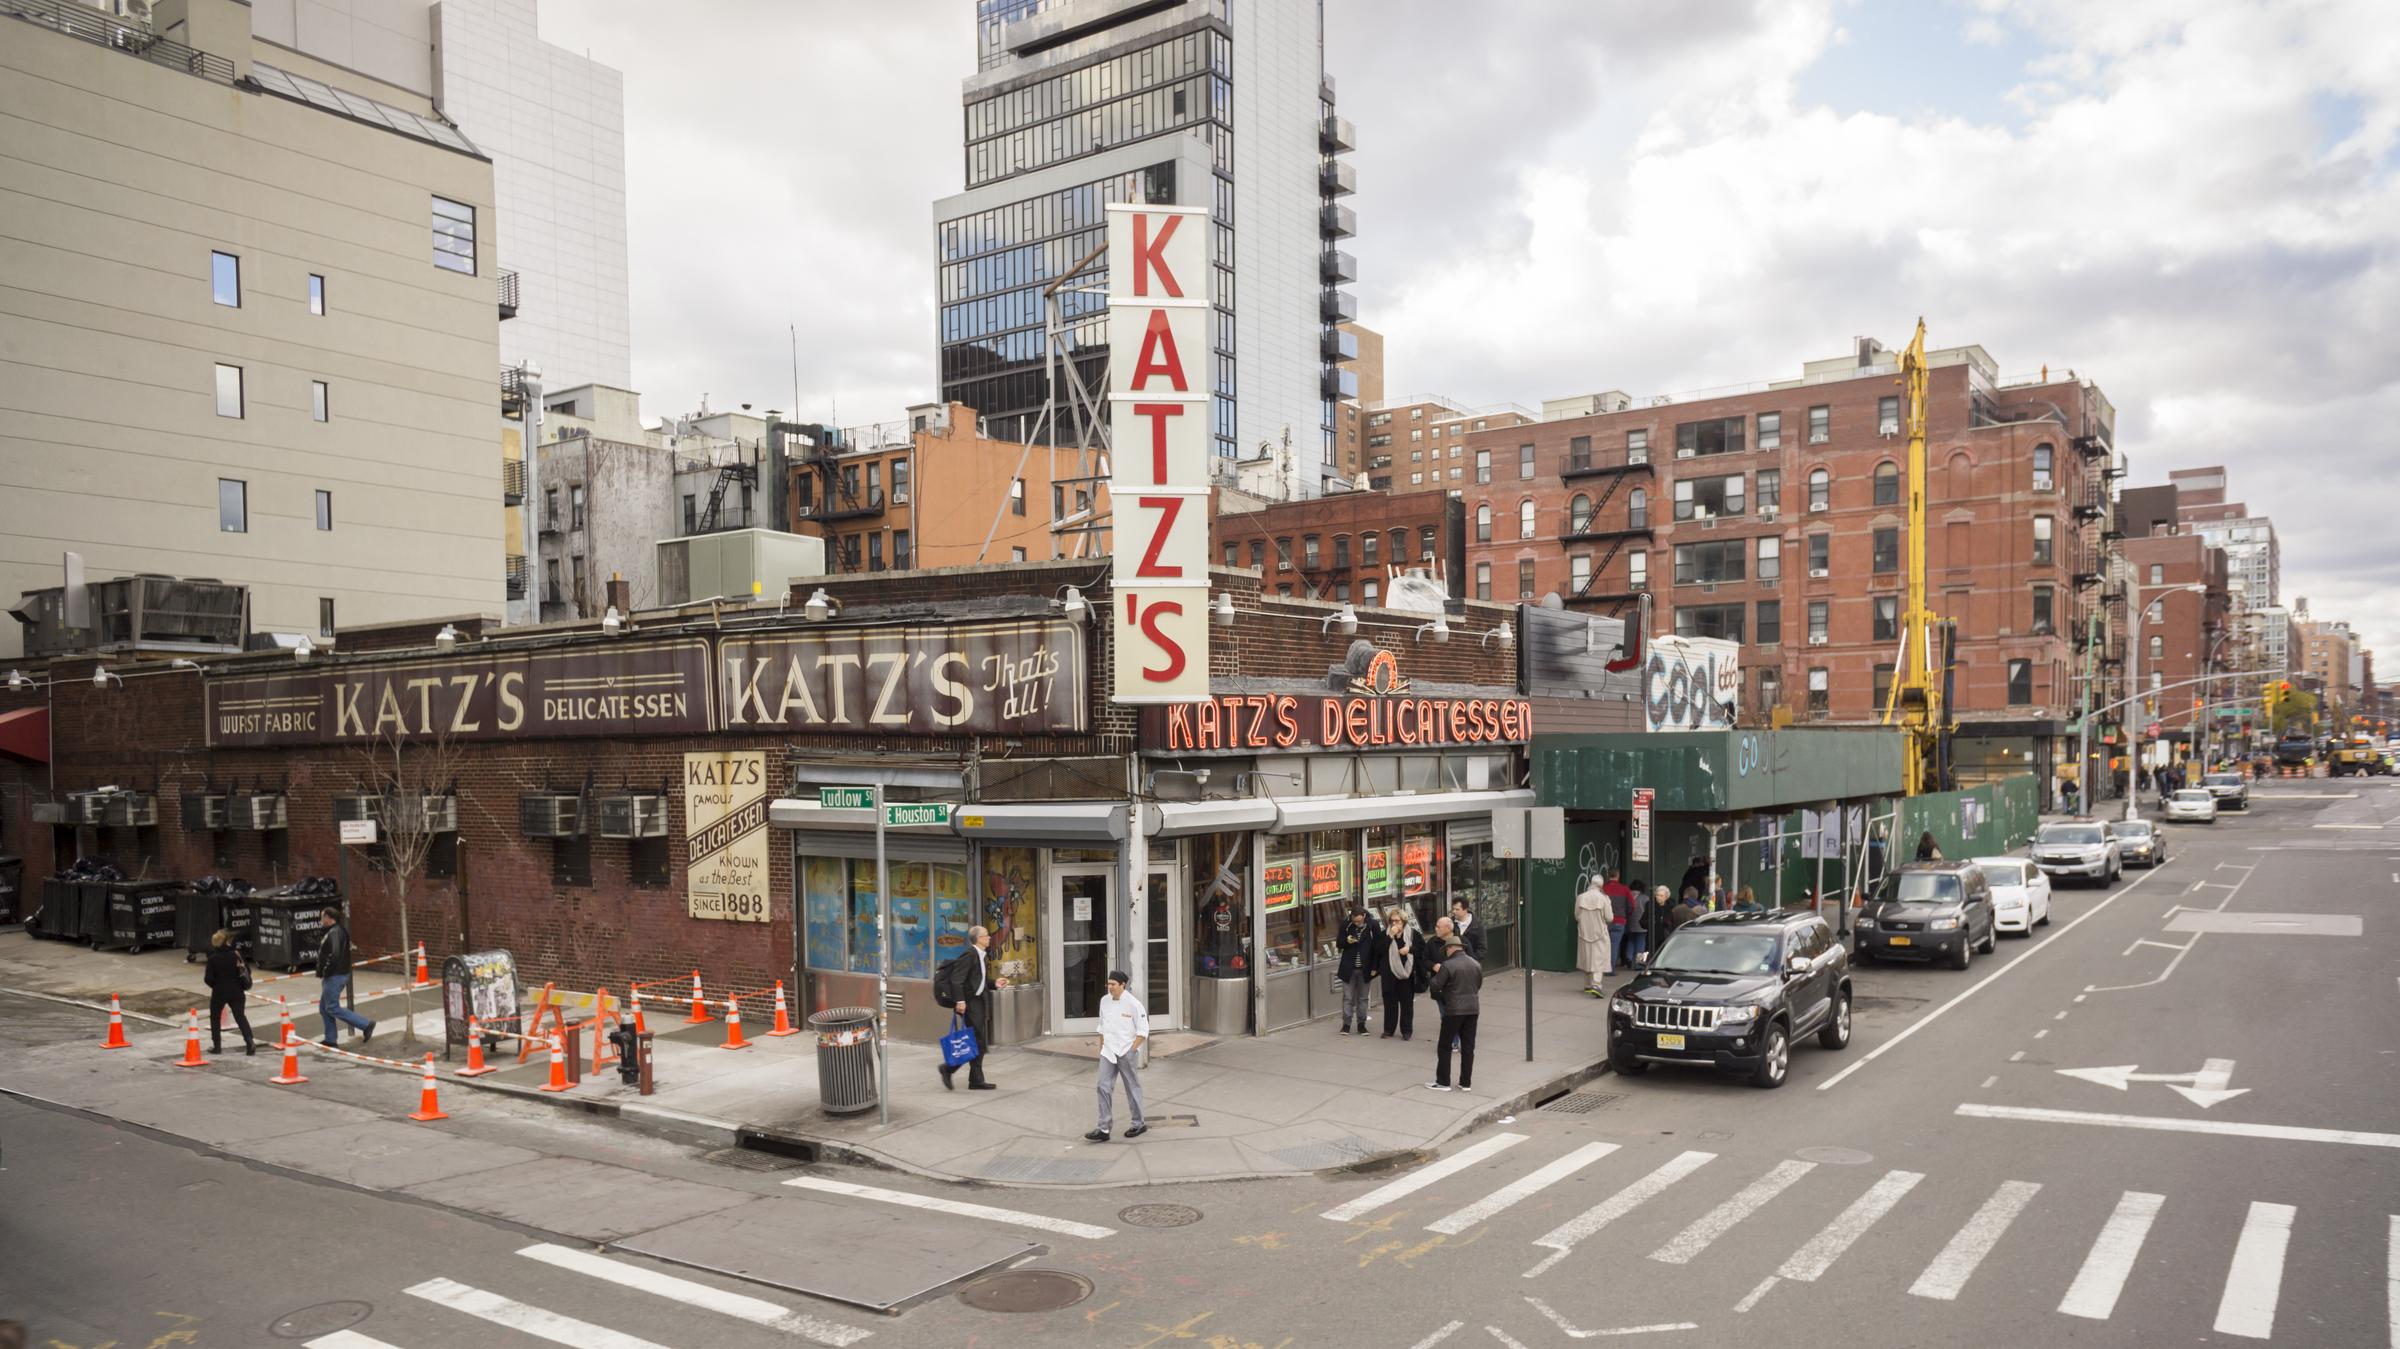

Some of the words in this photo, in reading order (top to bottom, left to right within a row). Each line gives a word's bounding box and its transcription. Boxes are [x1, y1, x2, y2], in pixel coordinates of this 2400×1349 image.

[1126, 213, 1188, 683] KATZ'S
[728, 650, 975, 726] KATZ'S
[334, 671, 525, 738] KATZ'S
[543, 692, 688, 721] DELICATESSEN
[219, 713, 262, 734] WURST
[264, 711, 317, 733] FABRIC
[1168, 691, 1298, 750] KATZ'S
[1322, 697, 1533, 747] DELICATESSEN
[688, 758, 760, 786] KATZ'S
[821, 790, 862, 808] Ludlow
[865, 790, 873, 801] St
[886, 808, 892, 824] E
[895, 807, 936, 823] Houston
[938, 805, 946, 817] St
[689, 801, 764, 863] DELICATESSEN
[719, 856, 759, 869] KNOWN
[699, 875, 710, 884] as
[711, 871, 728, 885] the
[727, 870, 753, 886] Best
[693, 899, 721, 912] SINCE
